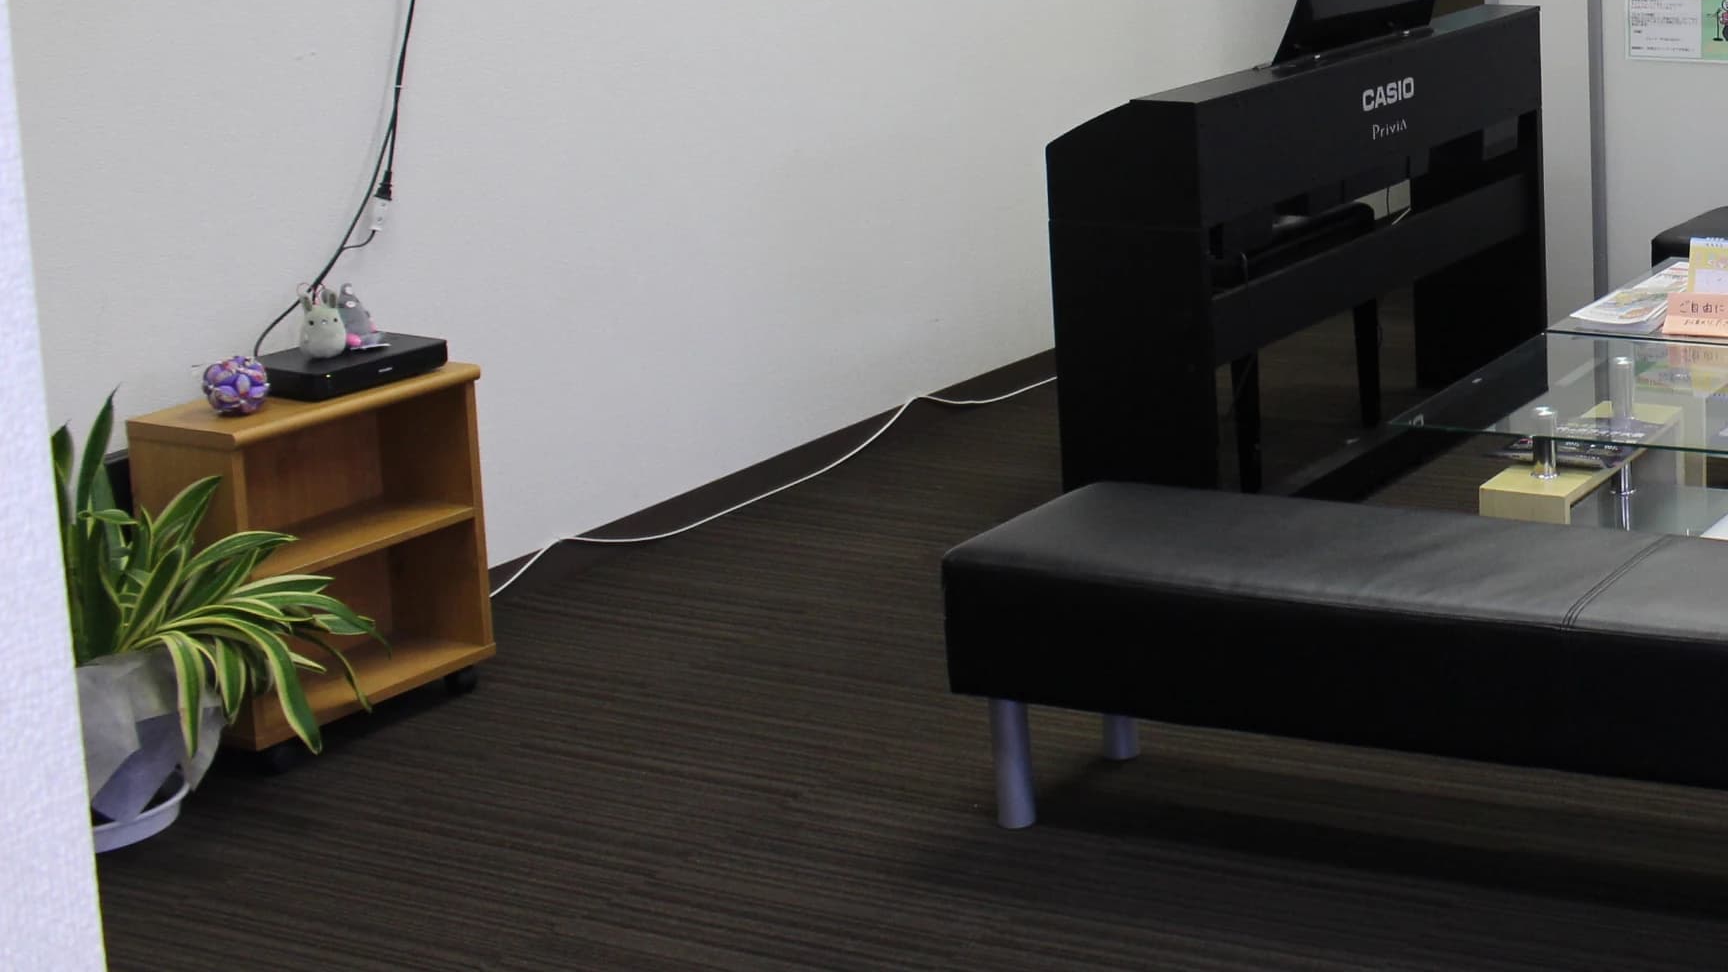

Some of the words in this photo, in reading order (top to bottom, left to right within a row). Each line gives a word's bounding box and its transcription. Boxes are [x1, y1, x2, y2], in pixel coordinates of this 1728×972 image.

[1362, 76, 1415, 112] CASIO
[1680, 299, 1726, 314] ご自由に
